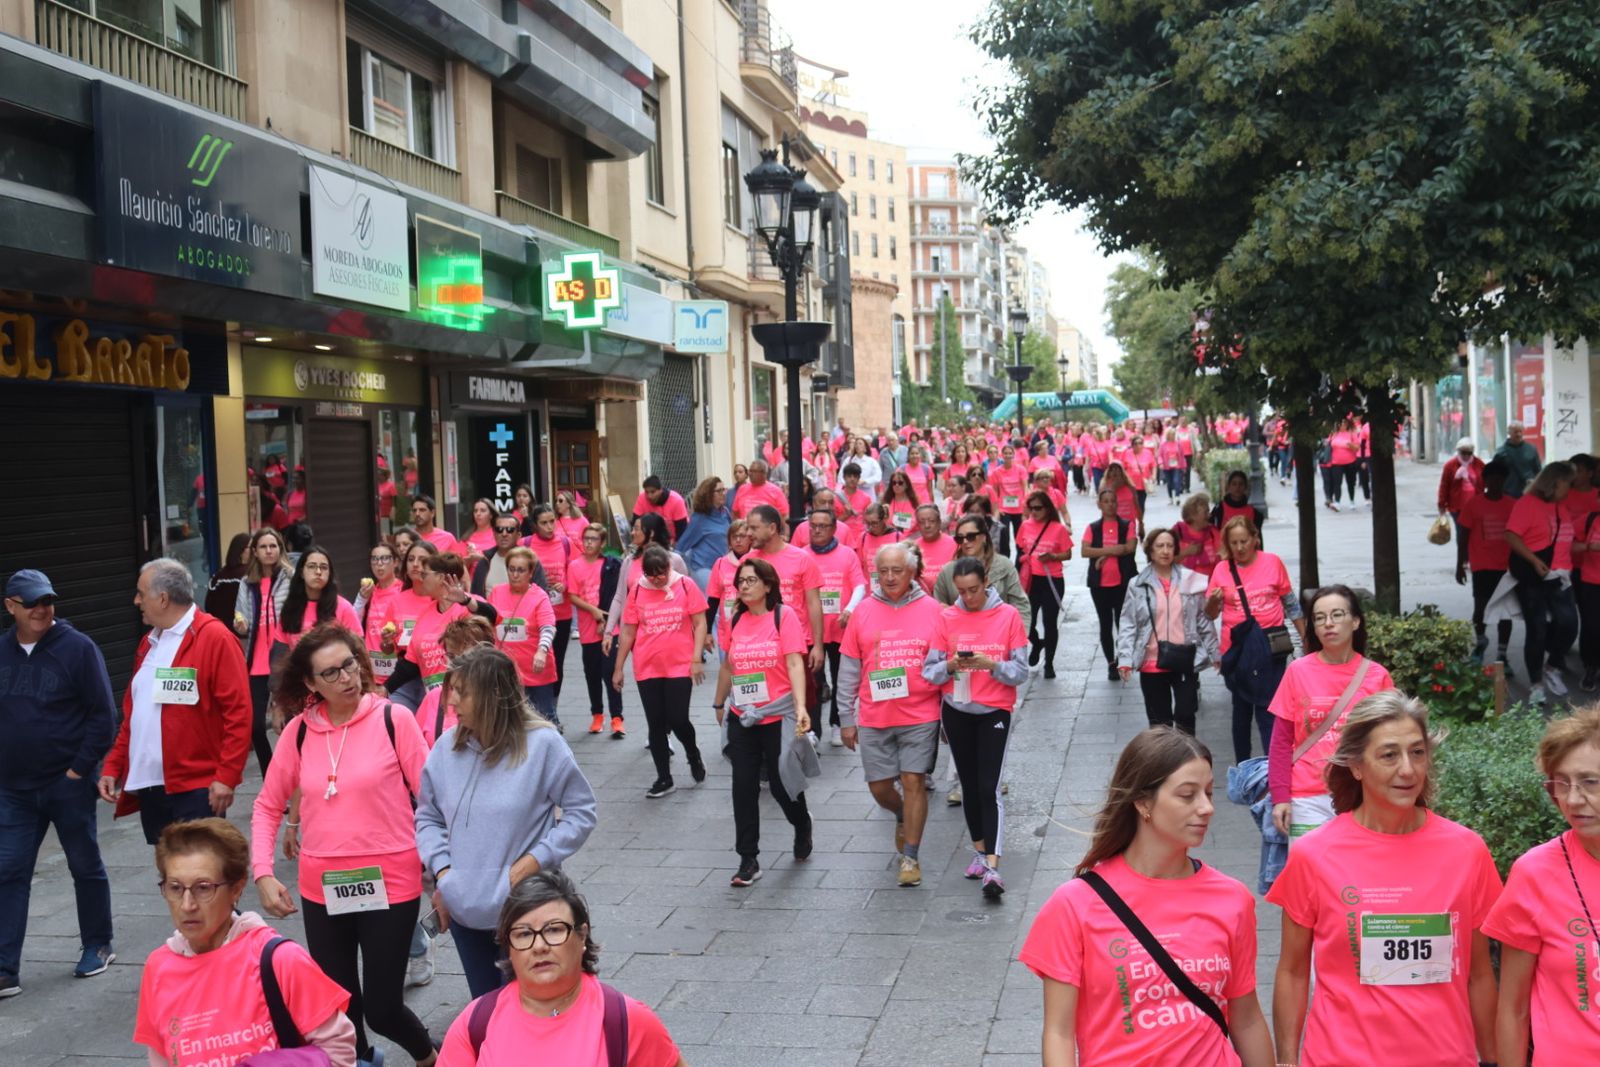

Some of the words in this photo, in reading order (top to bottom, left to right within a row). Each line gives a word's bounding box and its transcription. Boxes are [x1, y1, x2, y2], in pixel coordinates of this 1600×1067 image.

[120, 177, 182, 229] Mauricio
[189, 193, 242, 243] Sánchez
[246, 212, 291, 254] Lorenzo
[178, 245, 250, 276] ABOGADOS
[324, 246, 360, 269] MOREDA
[362, 256, 402, 279] ABOGADOS
[330, 266, 368, 290] ASESORES
[0, 313, 52, 380] EL
[679, 335, 722, 346] randstad
[311, 367, 340, 386] YVES
[342, 369, 386, 391] ROCHER
[469, 376, 526, 403] FARMACIA
[494, 452, 514, 512] FARM
[733, 650, 765, 660] contra
[766, 648, 777, 657] el
[880, 640, 892, 648] En
[893, 638, 927, 647] marcha
[880, 649, 914, 658] contra
[735, 657, 778, 670] cáncer
[162, 680, 194, 692] 10262
[334, 881, 375, 898] 10263
[1383, 939, 1432, 961] 3815
[1130, 961, 1158, 980] En
[1576, 941, 1589, 1012] SALAMANCA
[1115, 965, 1134, 1034] SALAMANCA
[180, 1038, 202, 1057] En
[205, 1021, 274, 1050] marcha
